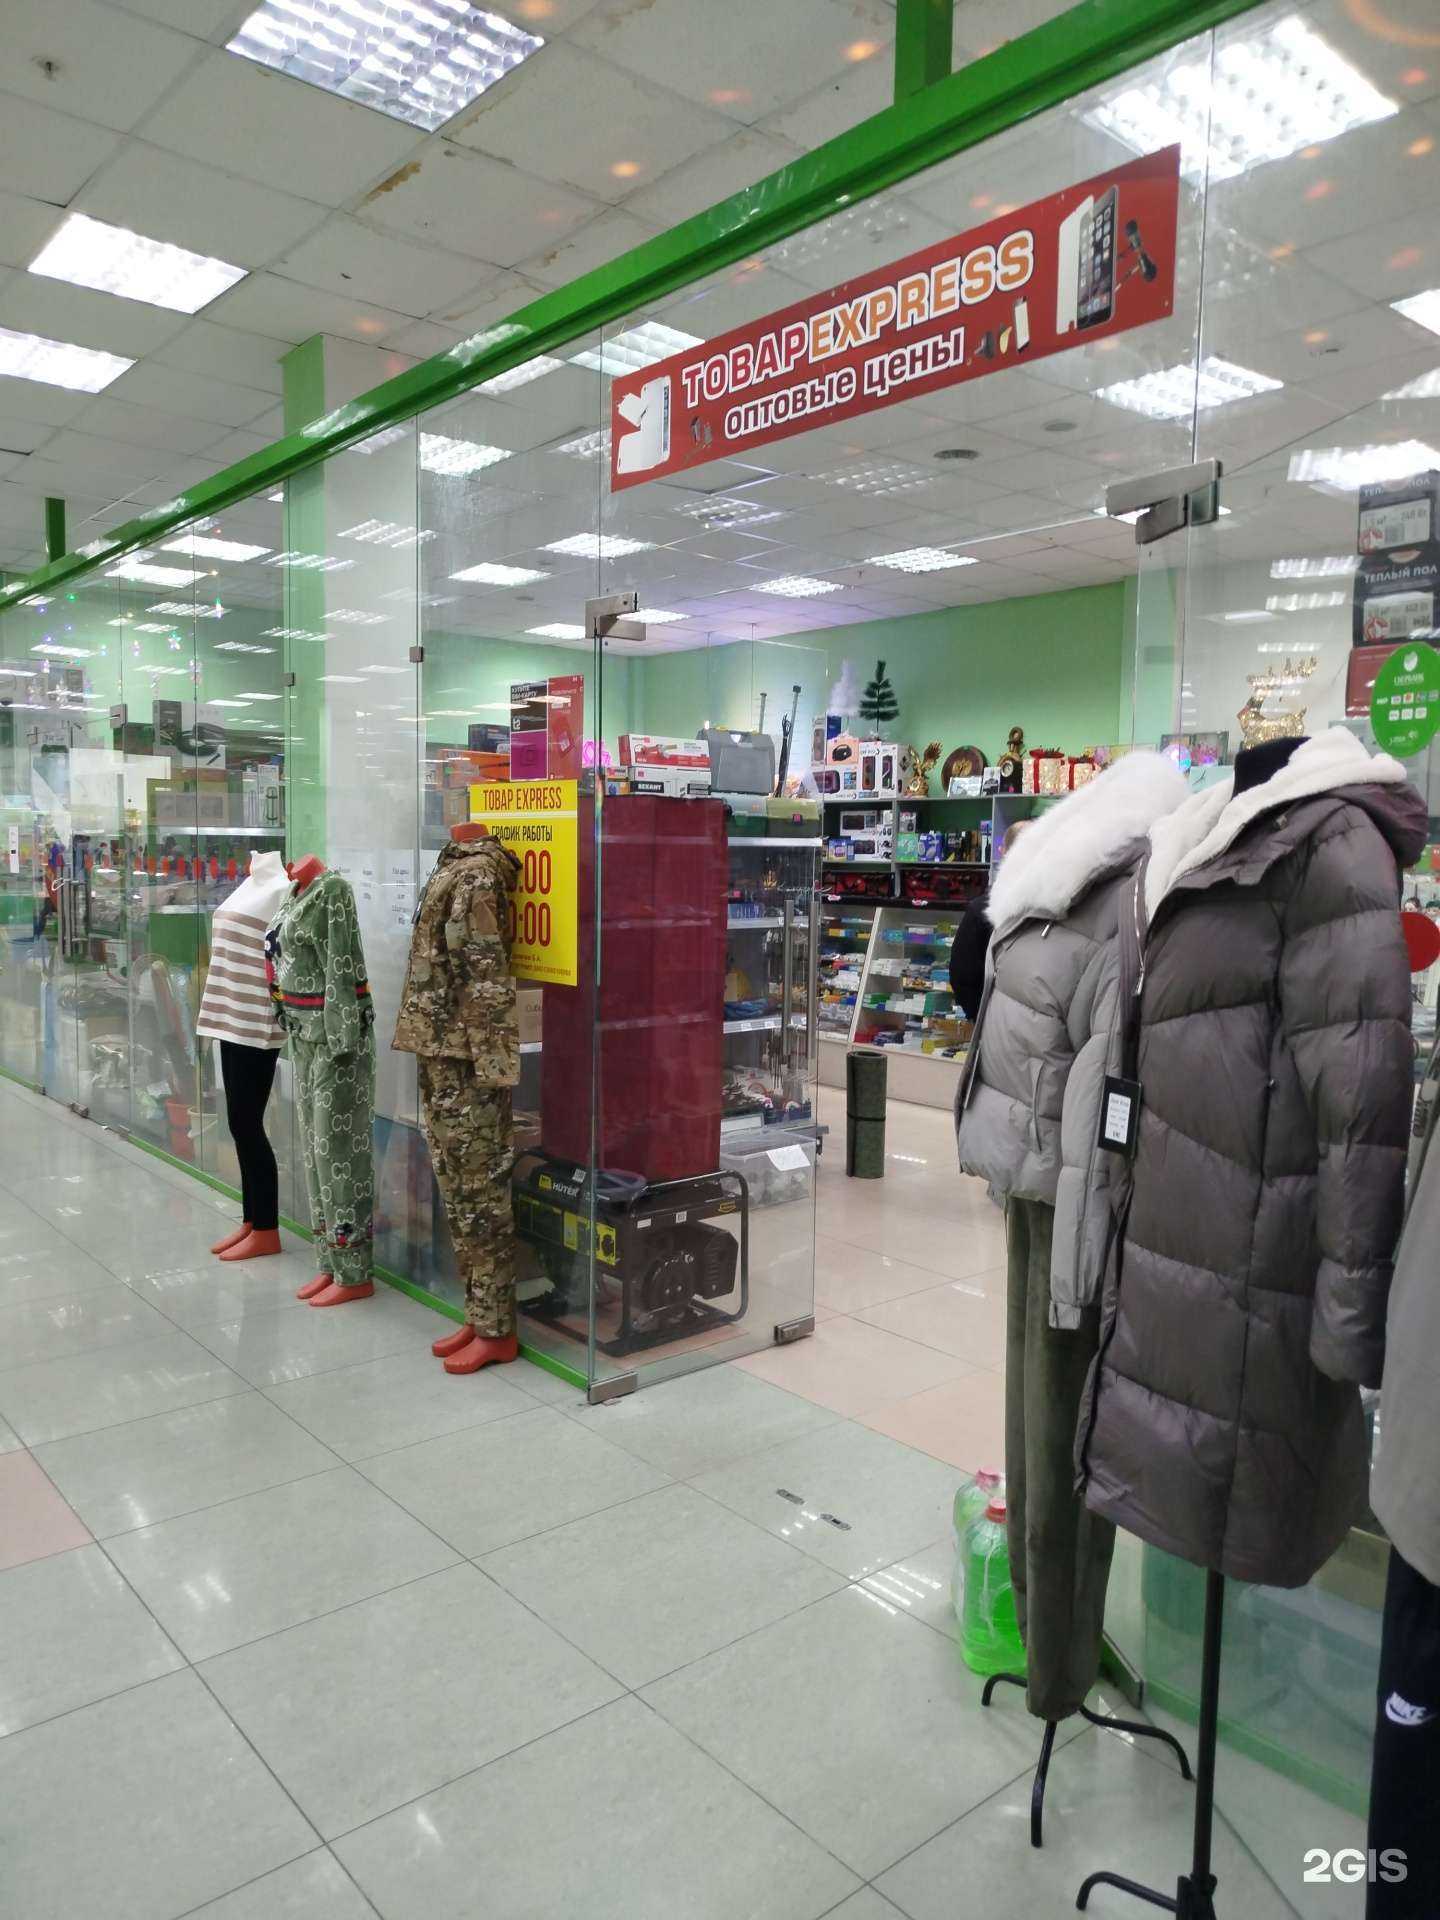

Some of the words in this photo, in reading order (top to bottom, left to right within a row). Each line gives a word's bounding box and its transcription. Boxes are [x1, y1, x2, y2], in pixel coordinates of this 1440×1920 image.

[1364, 566, 1411, 584] ТЕПЛЫЙ
[1413, 564, 1438, 577] ПОЛ
[637, 783, 663, 791] REXANT
[483, 789, 514, 811] ТОВАР
[516, 786, 562, 810] EXPRESS
[491, 825, 521, 841] ГРАФИК
[522, 825, 553, 842] РАБОТЫ
